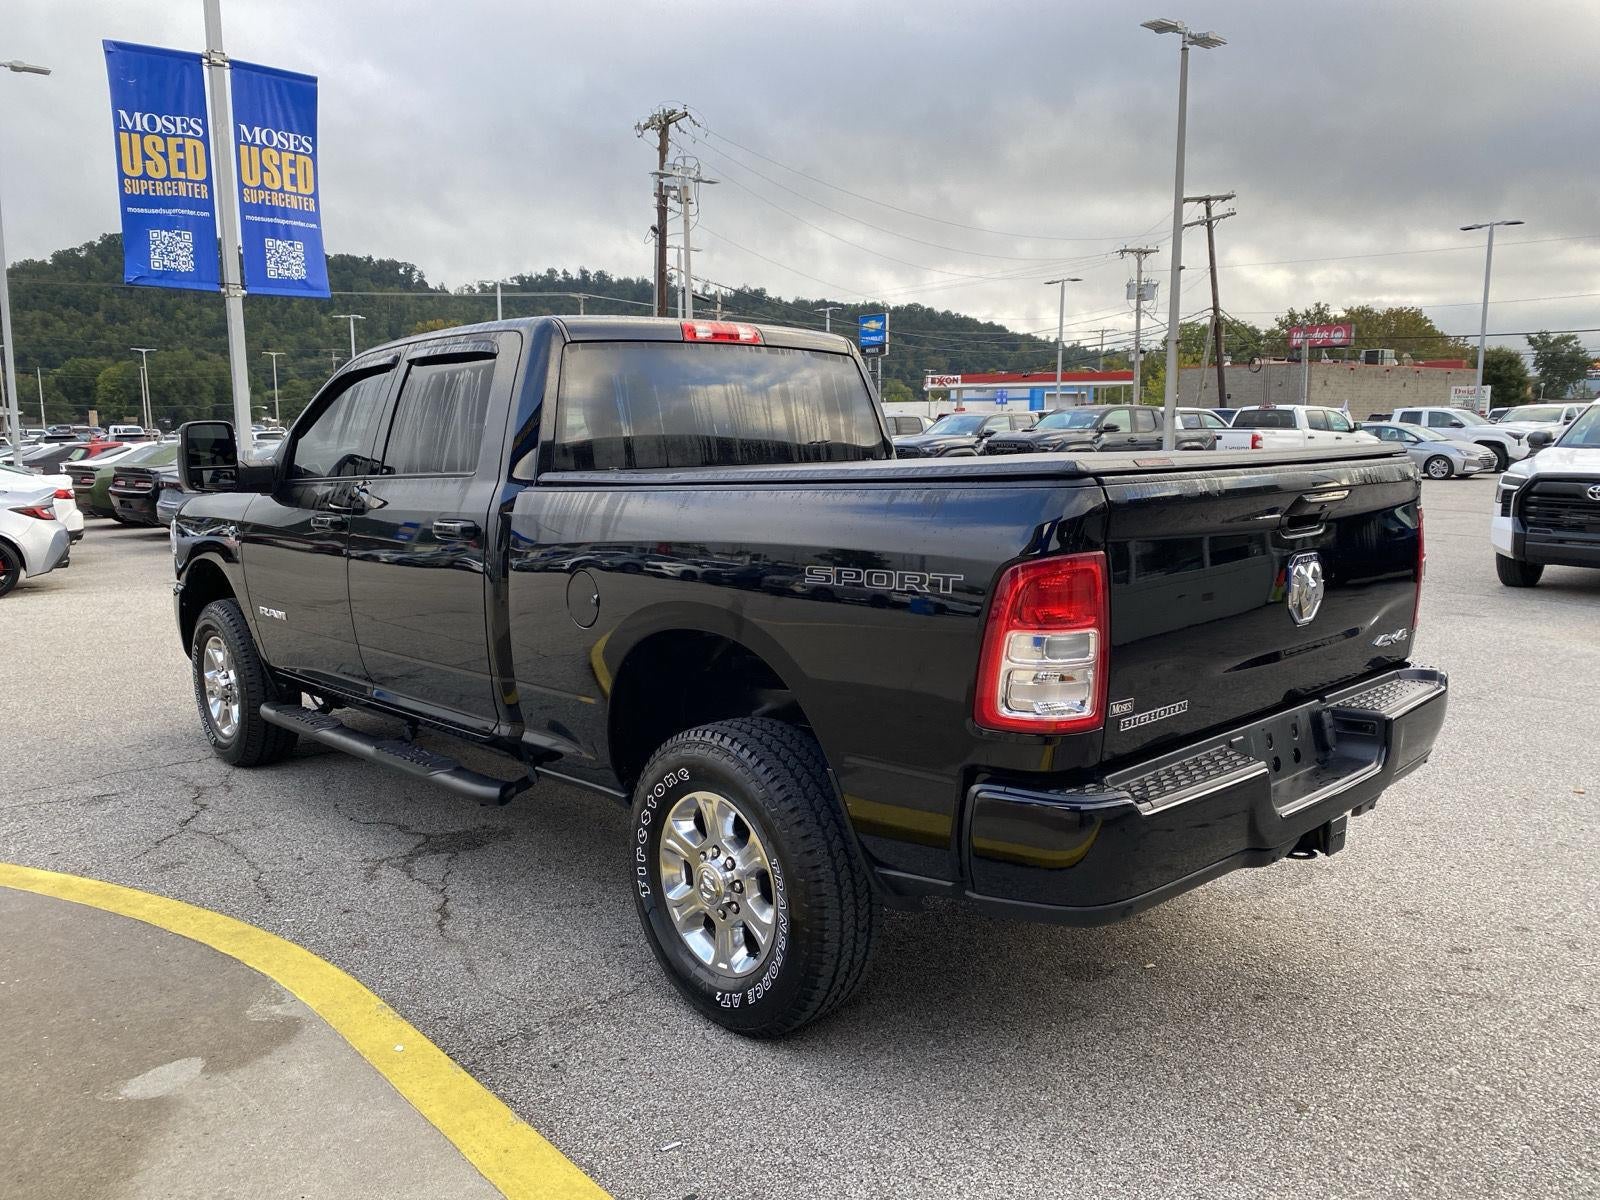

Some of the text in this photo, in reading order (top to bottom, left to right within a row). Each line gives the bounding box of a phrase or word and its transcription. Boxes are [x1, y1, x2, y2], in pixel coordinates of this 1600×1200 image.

[117, 109, 204, 138] MOSES
[238, 123, 313, 154] MOSES
[119, 131, 207, 181] USED
[239, 144, 315, 195] USED
[123, 178, 209, 199] SUPERCENTER
[243, 187, 316, 212] SUPERCENTER
[126, 205, 210, 217] mosesusedsupercenter.com
[245, 214, 318, 229] mosesusedsupercenter.com
[930, 376, 959, 387] EXXON
[804, 564, 965, 595] SPORT
[259, 605, 288, 621] RAM
[1111, 702, 1132, 715] MOSES
[1120, 699, 1188, 731] BIGHORN
[636, 767, 690, 898] Firestone
[748, 858, 789, 1005] TRANSFORCE
